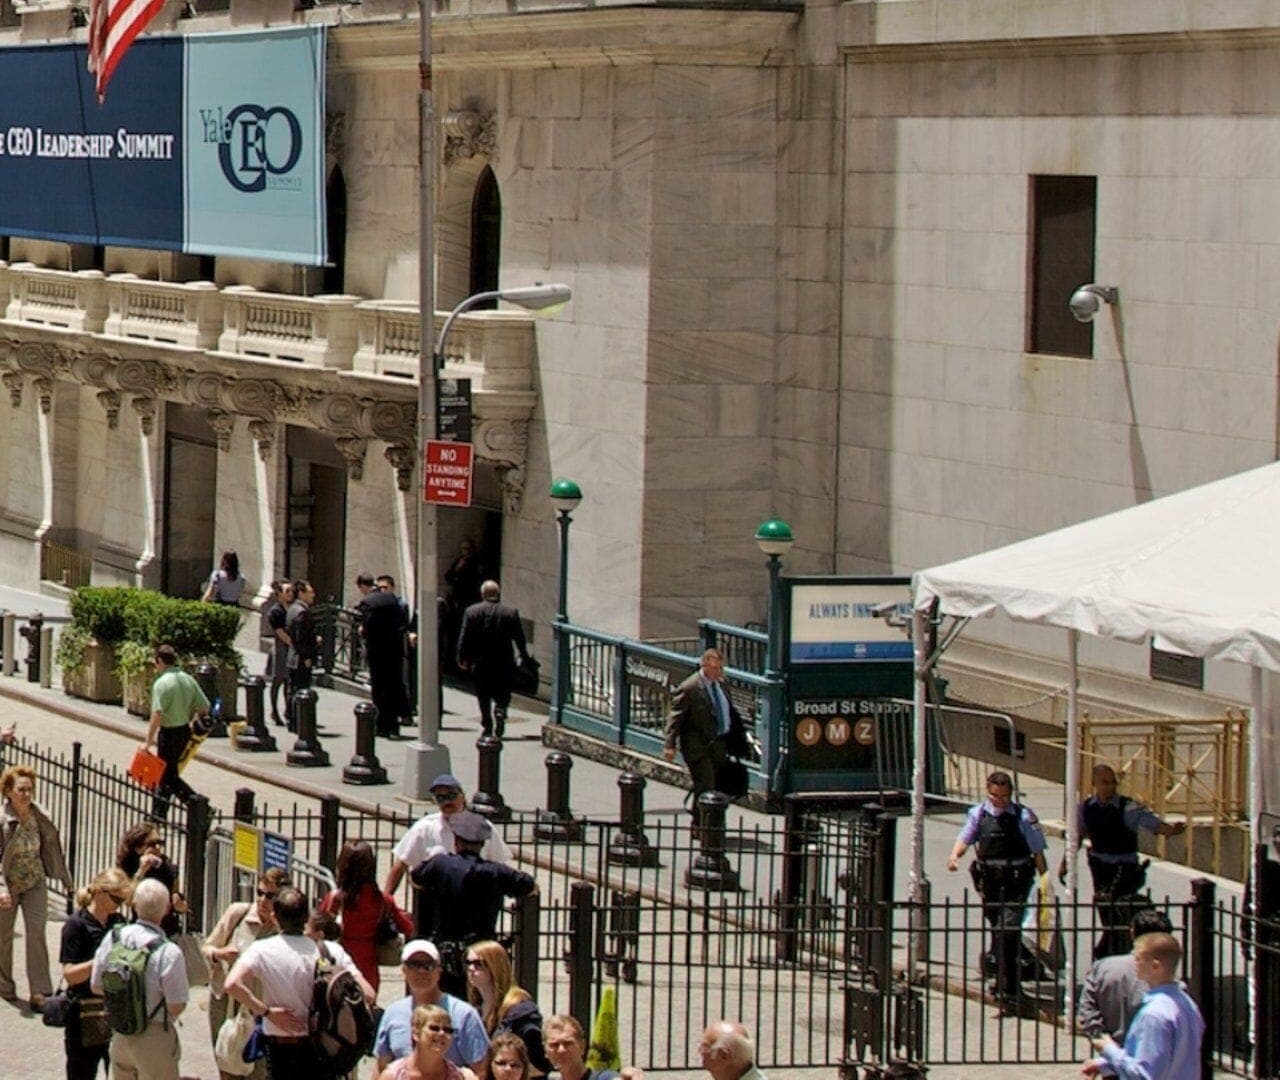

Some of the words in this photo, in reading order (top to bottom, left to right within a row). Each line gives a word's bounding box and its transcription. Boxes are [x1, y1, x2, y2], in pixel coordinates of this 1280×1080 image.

[200, 106, 233, 143] Yale
[7, 127, 33, 157] CEO
[37, 127, 114, 158] LEADERSHIP
[117, 128, 174, 159] SUMMIT
[441, 449, 456, 461] NO
[426, 464, 470, 477] STANDING
[429, 478, 466, 489] ANYTIME
[808, 602, 849, 619] ALWAYS
[626, 656, 669, 687] Subway
[795, 700, 837, 715] Broad
[841, 700, 856, 714] St
[804, 724, 814, 740] J
[829, 723, 846, 739] M
[860, 723, 872, 739] Z
